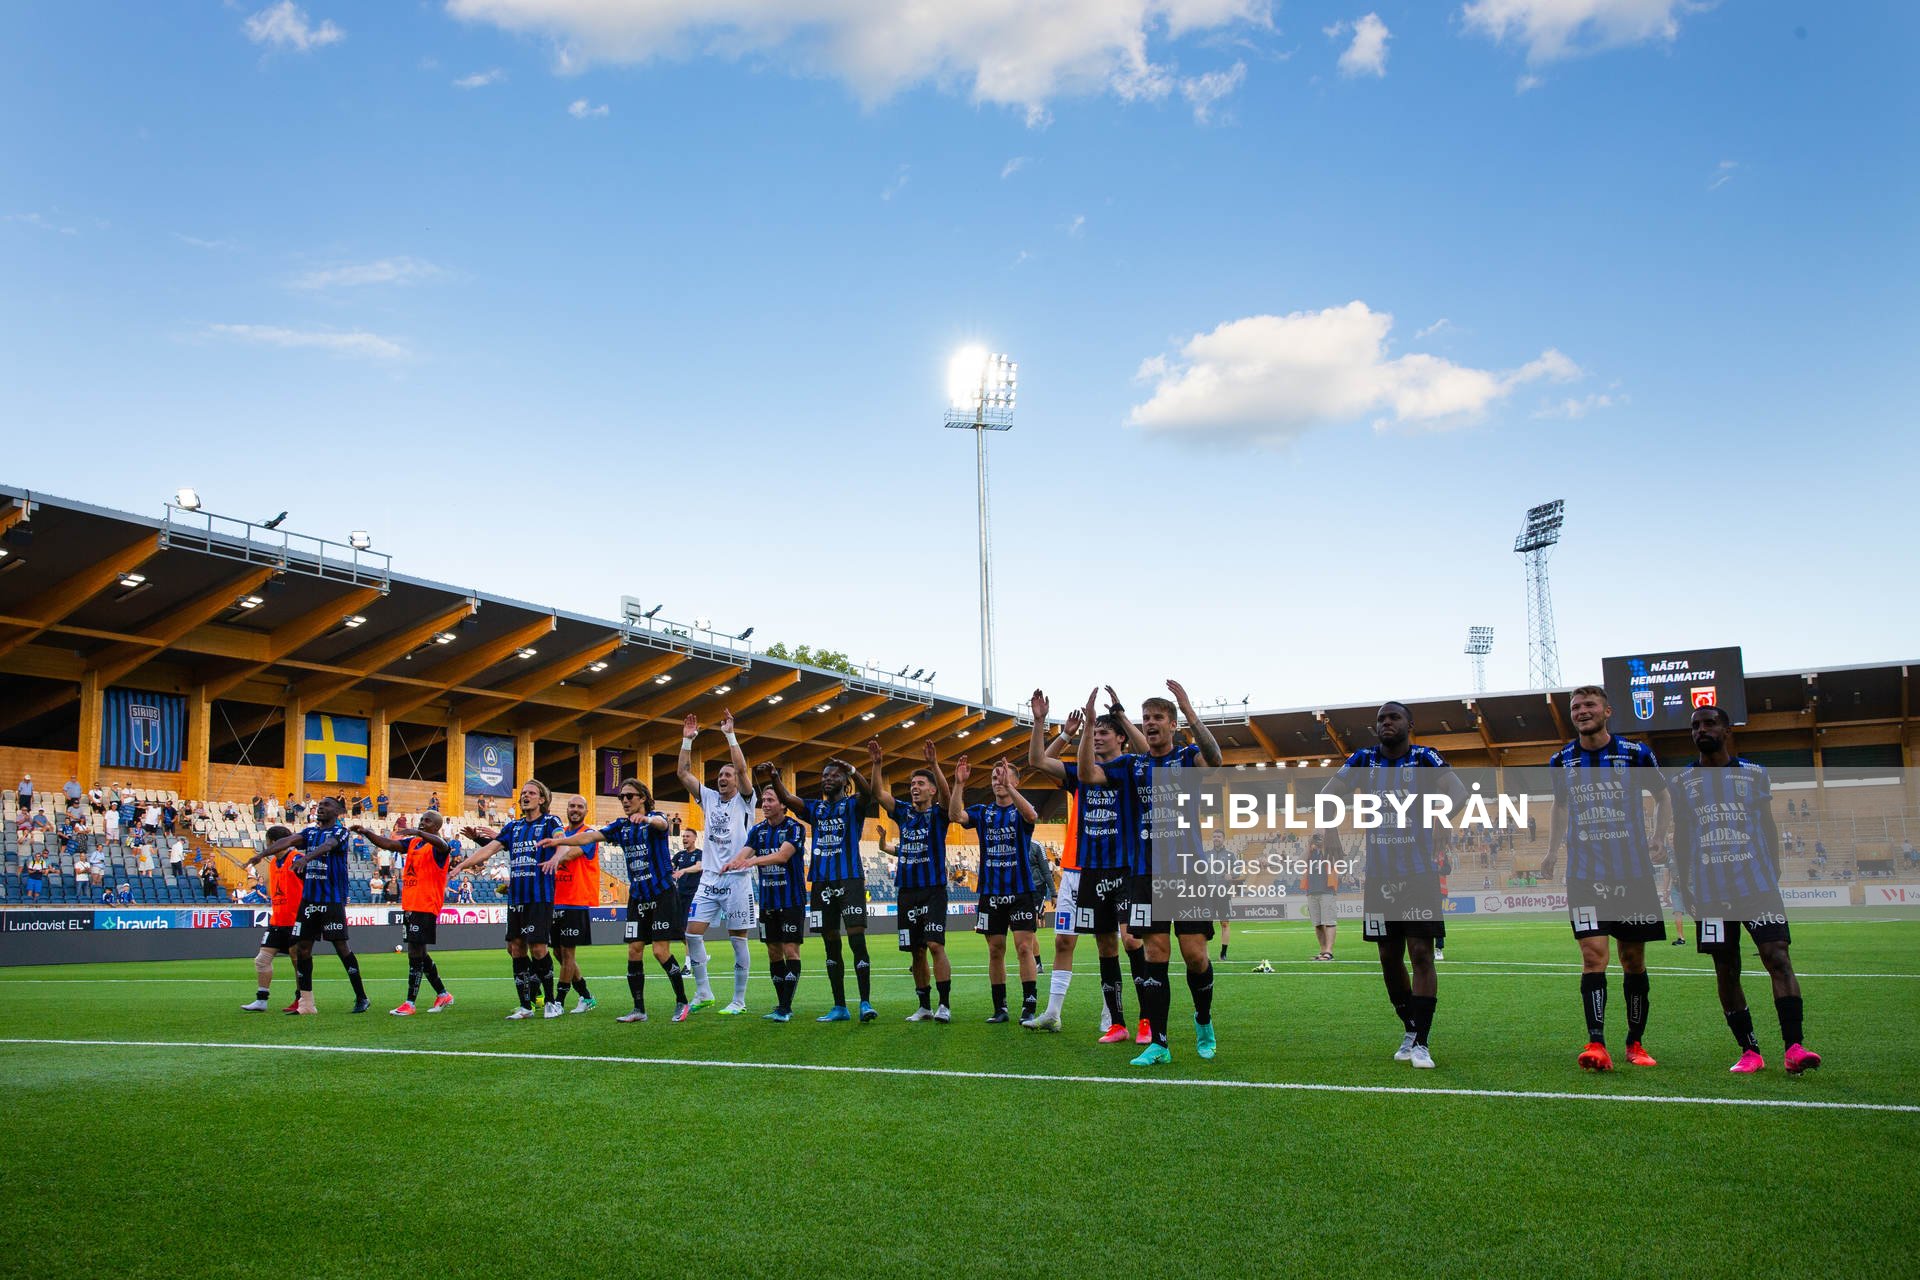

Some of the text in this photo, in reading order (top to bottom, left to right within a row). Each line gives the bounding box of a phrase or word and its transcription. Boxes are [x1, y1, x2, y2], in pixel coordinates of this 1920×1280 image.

[1650, 660, 1690, 672] NÄSTA
[1630, 670, 1716, 686] HEMMAMATCH
[132, 707, 158, 719] SIRIUS
[1570, 783, 1594, 795] BYGG
[1573, 790, 1626, 804] CONSTRUCT
[1695, 803, 1718, 816] BYGG
[1699, 812, 1748, 825] CONSTRUCT
[1376, 836, 1416, 845] BILFORUM
[1588, 830, 1630, 841] BILFORUM
[1710, 852, 1753, 864] BILFORUM
[704, 885, 732, 897] gibon
[1244, 907, 1279, 917] inkClub
[69, 919, 84, 930] EL
[193, 911, 233, 928] UFS
